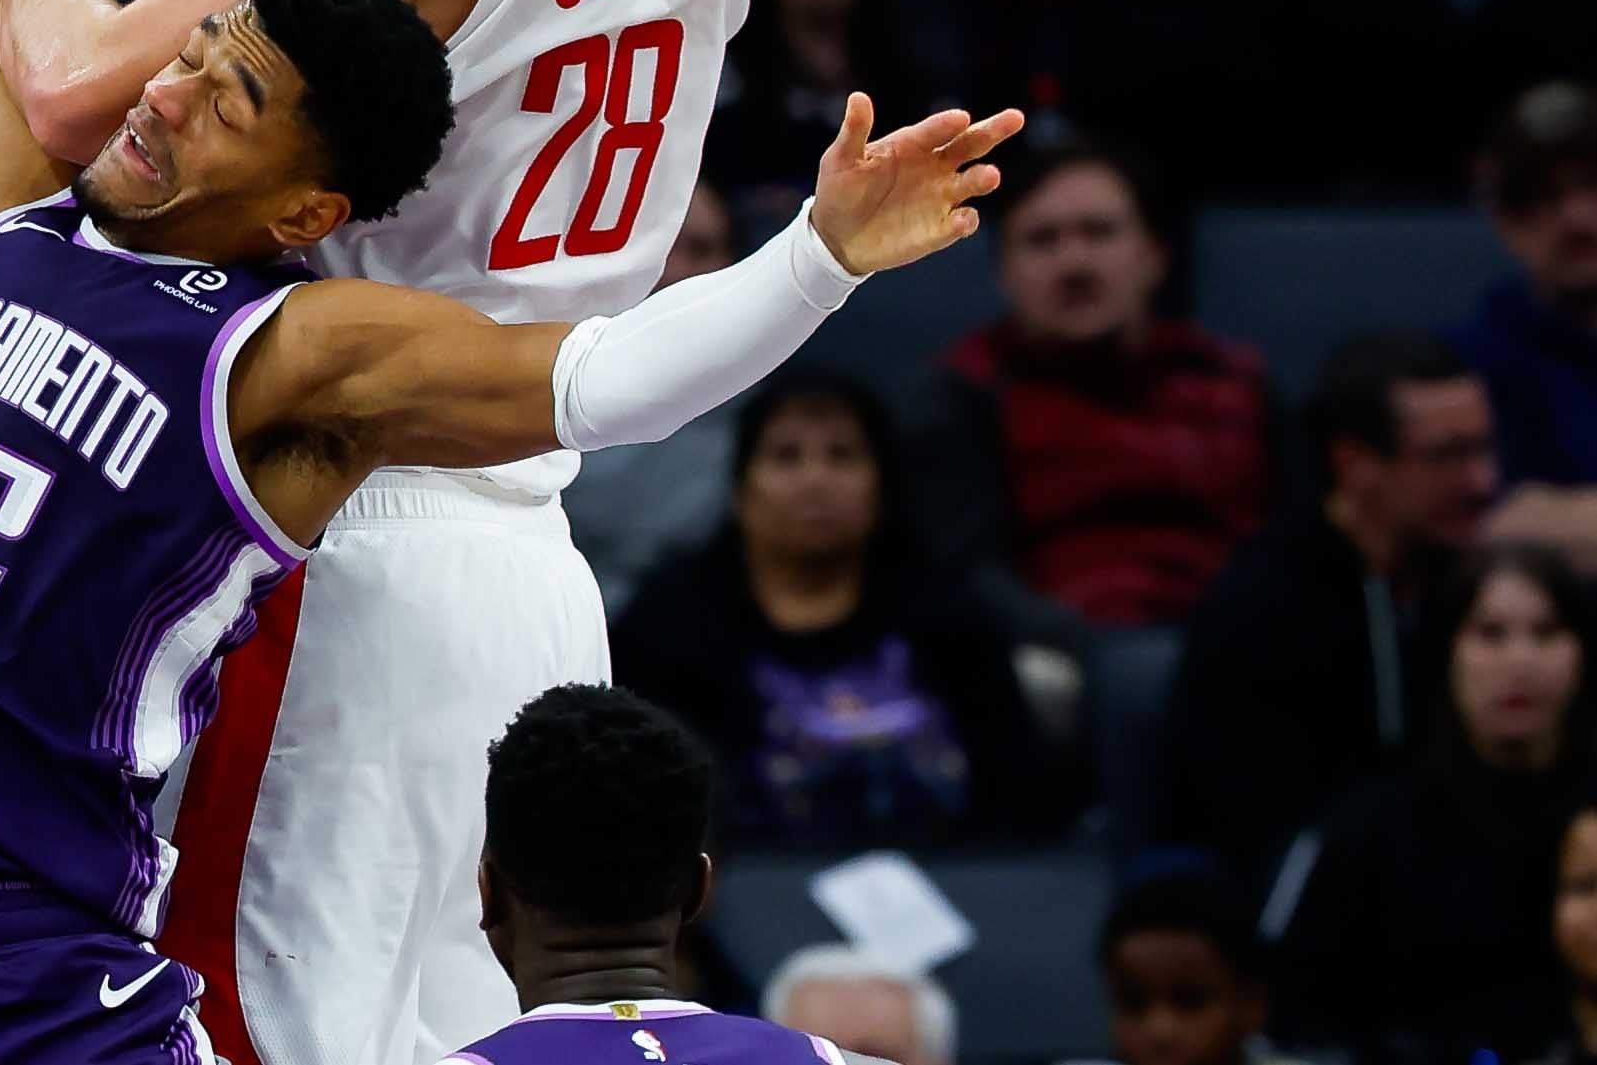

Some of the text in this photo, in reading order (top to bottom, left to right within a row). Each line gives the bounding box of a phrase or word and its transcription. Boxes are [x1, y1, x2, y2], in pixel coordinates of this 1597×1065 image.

[487, 17, 685, 271] 28
[152, 279, 219, 314] PHOONG LAW
